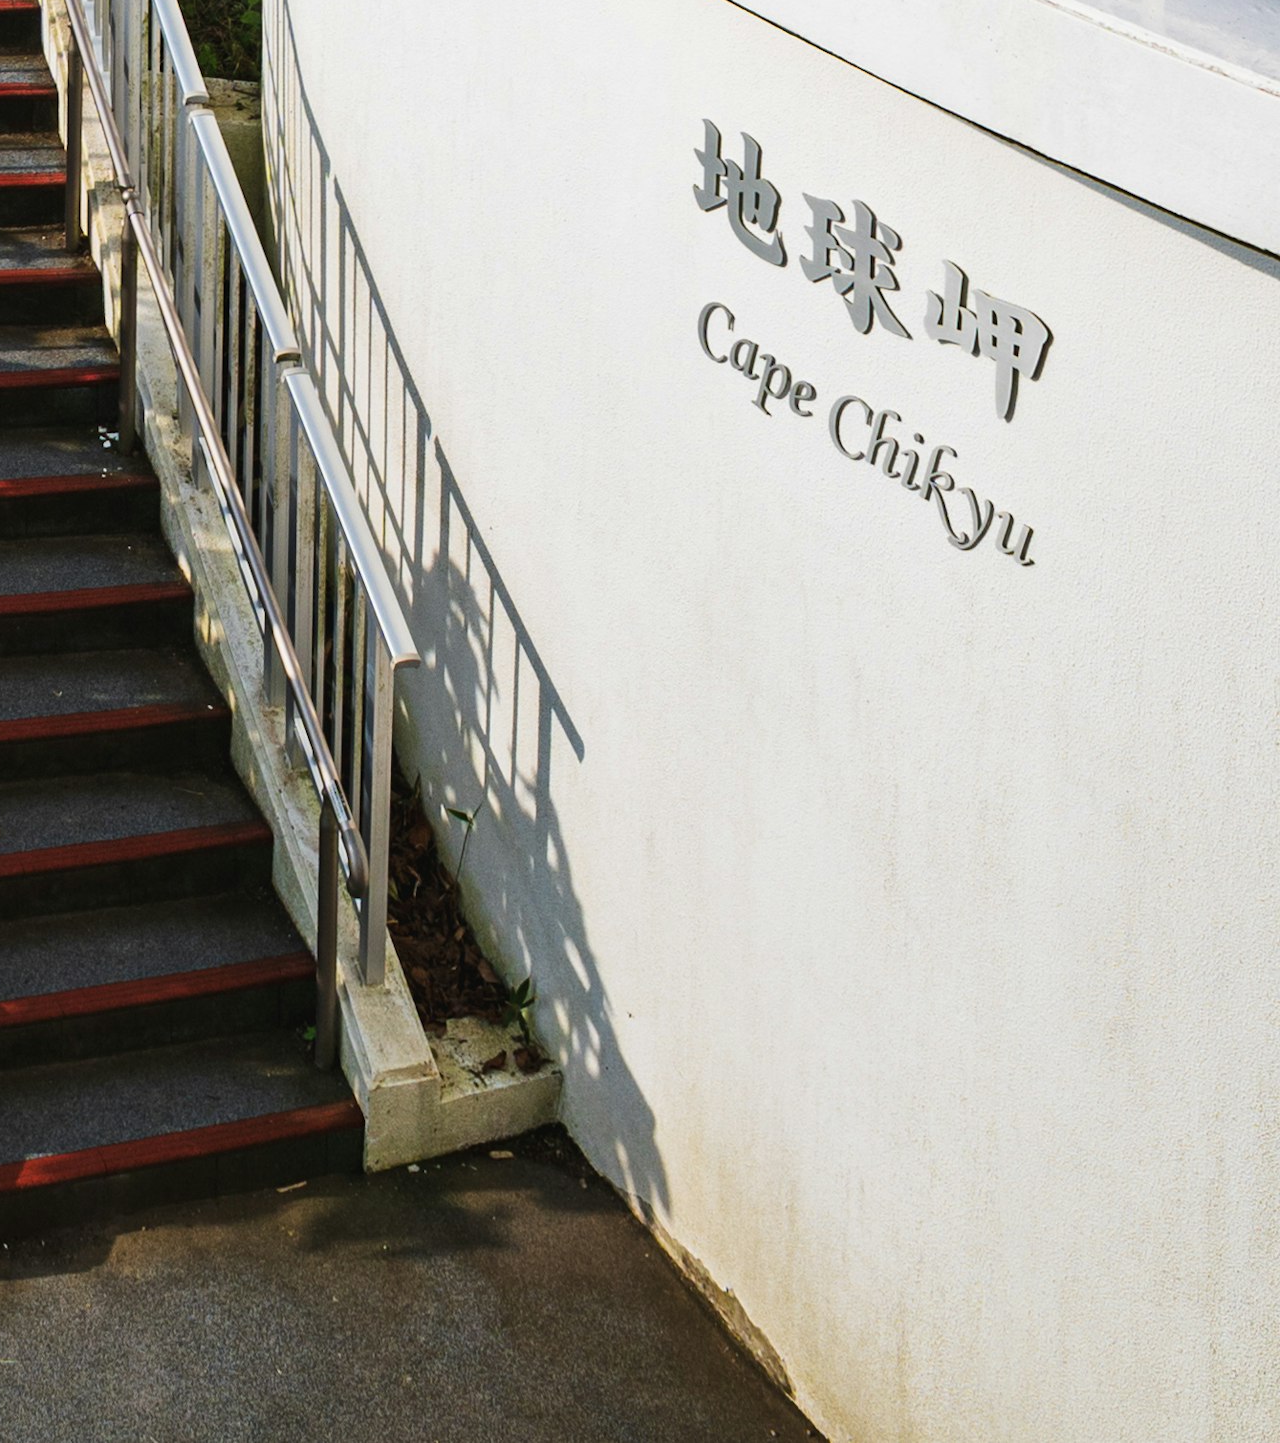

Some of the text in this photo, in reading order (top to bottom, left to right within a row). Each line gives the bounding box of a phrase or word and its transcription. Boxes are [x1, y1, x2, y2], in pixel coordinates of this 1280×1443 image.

[693, 118, 1053, 423] 地球岬
[697, 301, 1035, 567] Cape Chikyu
